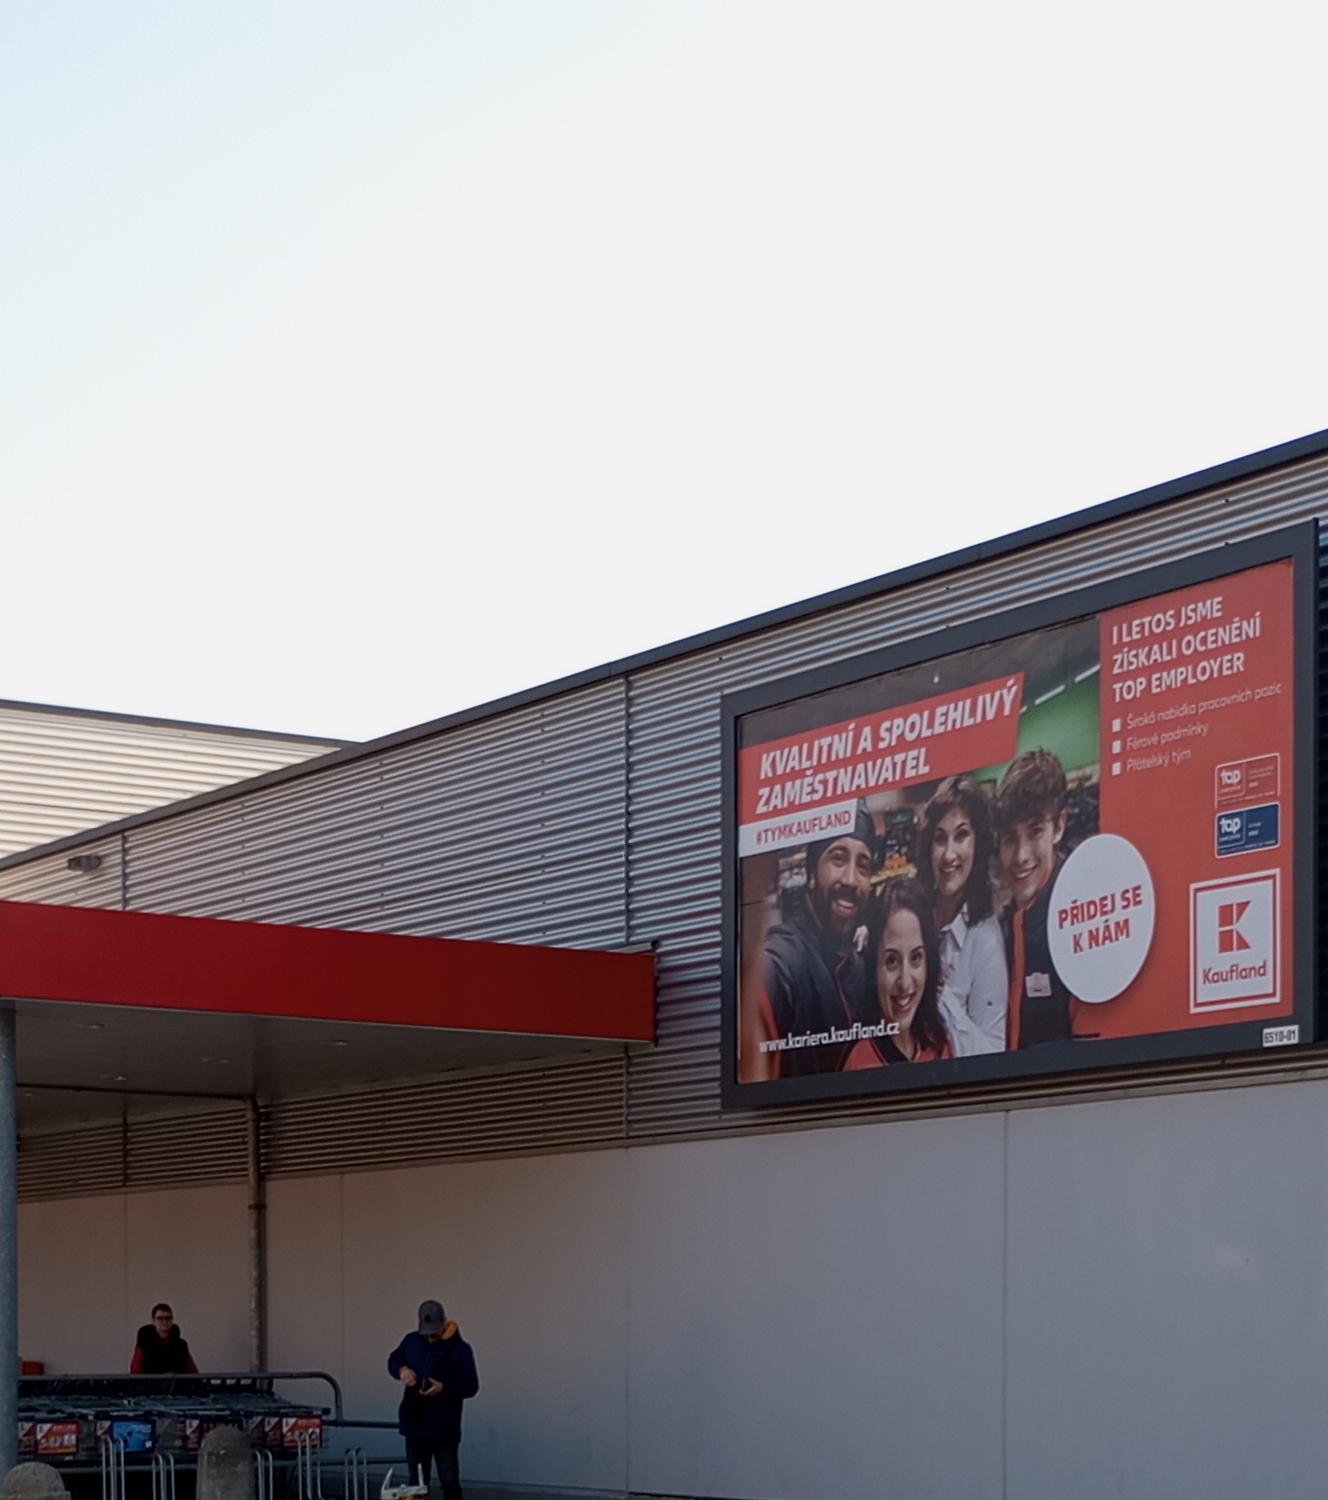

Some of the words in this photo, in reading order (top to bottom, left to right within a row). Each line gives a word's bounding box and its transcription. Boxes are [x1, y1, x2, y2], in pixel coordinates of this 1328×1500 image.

[1112, 626, 1118, 645] I
[1122, 610, 1175, 643] LETOS
[1179, 596, 1224, 627] JSME
[1112, 639, 1177, 675] ZÍSKALI
[1181, 611, 1262, 656] OCENĚNÍ
[1112, 677, 1147, 703] TOP
[1151, 652, 1245, 694] EMPLOYER
[760, 722, 857, 780] KVALITNÍ
[857, 726, 873, 755] A
[878, 679, 1018, 749] SPOLEHLIVÝ
[1171, 748, 1192, 766] tým
[755, 747, 931, 815] ZAMĚSTNAVATEL
[1221, 769, 1240, 785] top
[756, 810, 852, 846] #TYMKAUFLAND
[1220, 817, 1241, 834] top
[1058, 893, 1116, 930] PŘIDEJ
[1120, 884, 1143, 910] SE
[1072, 932, 1083, 954] K
[1088, 918, 1130, 949] NÁM
[1202, 959, 1267, 985] Kaufland
[759, 1018, 900, 1053] www.kariera.kaufland.cz
